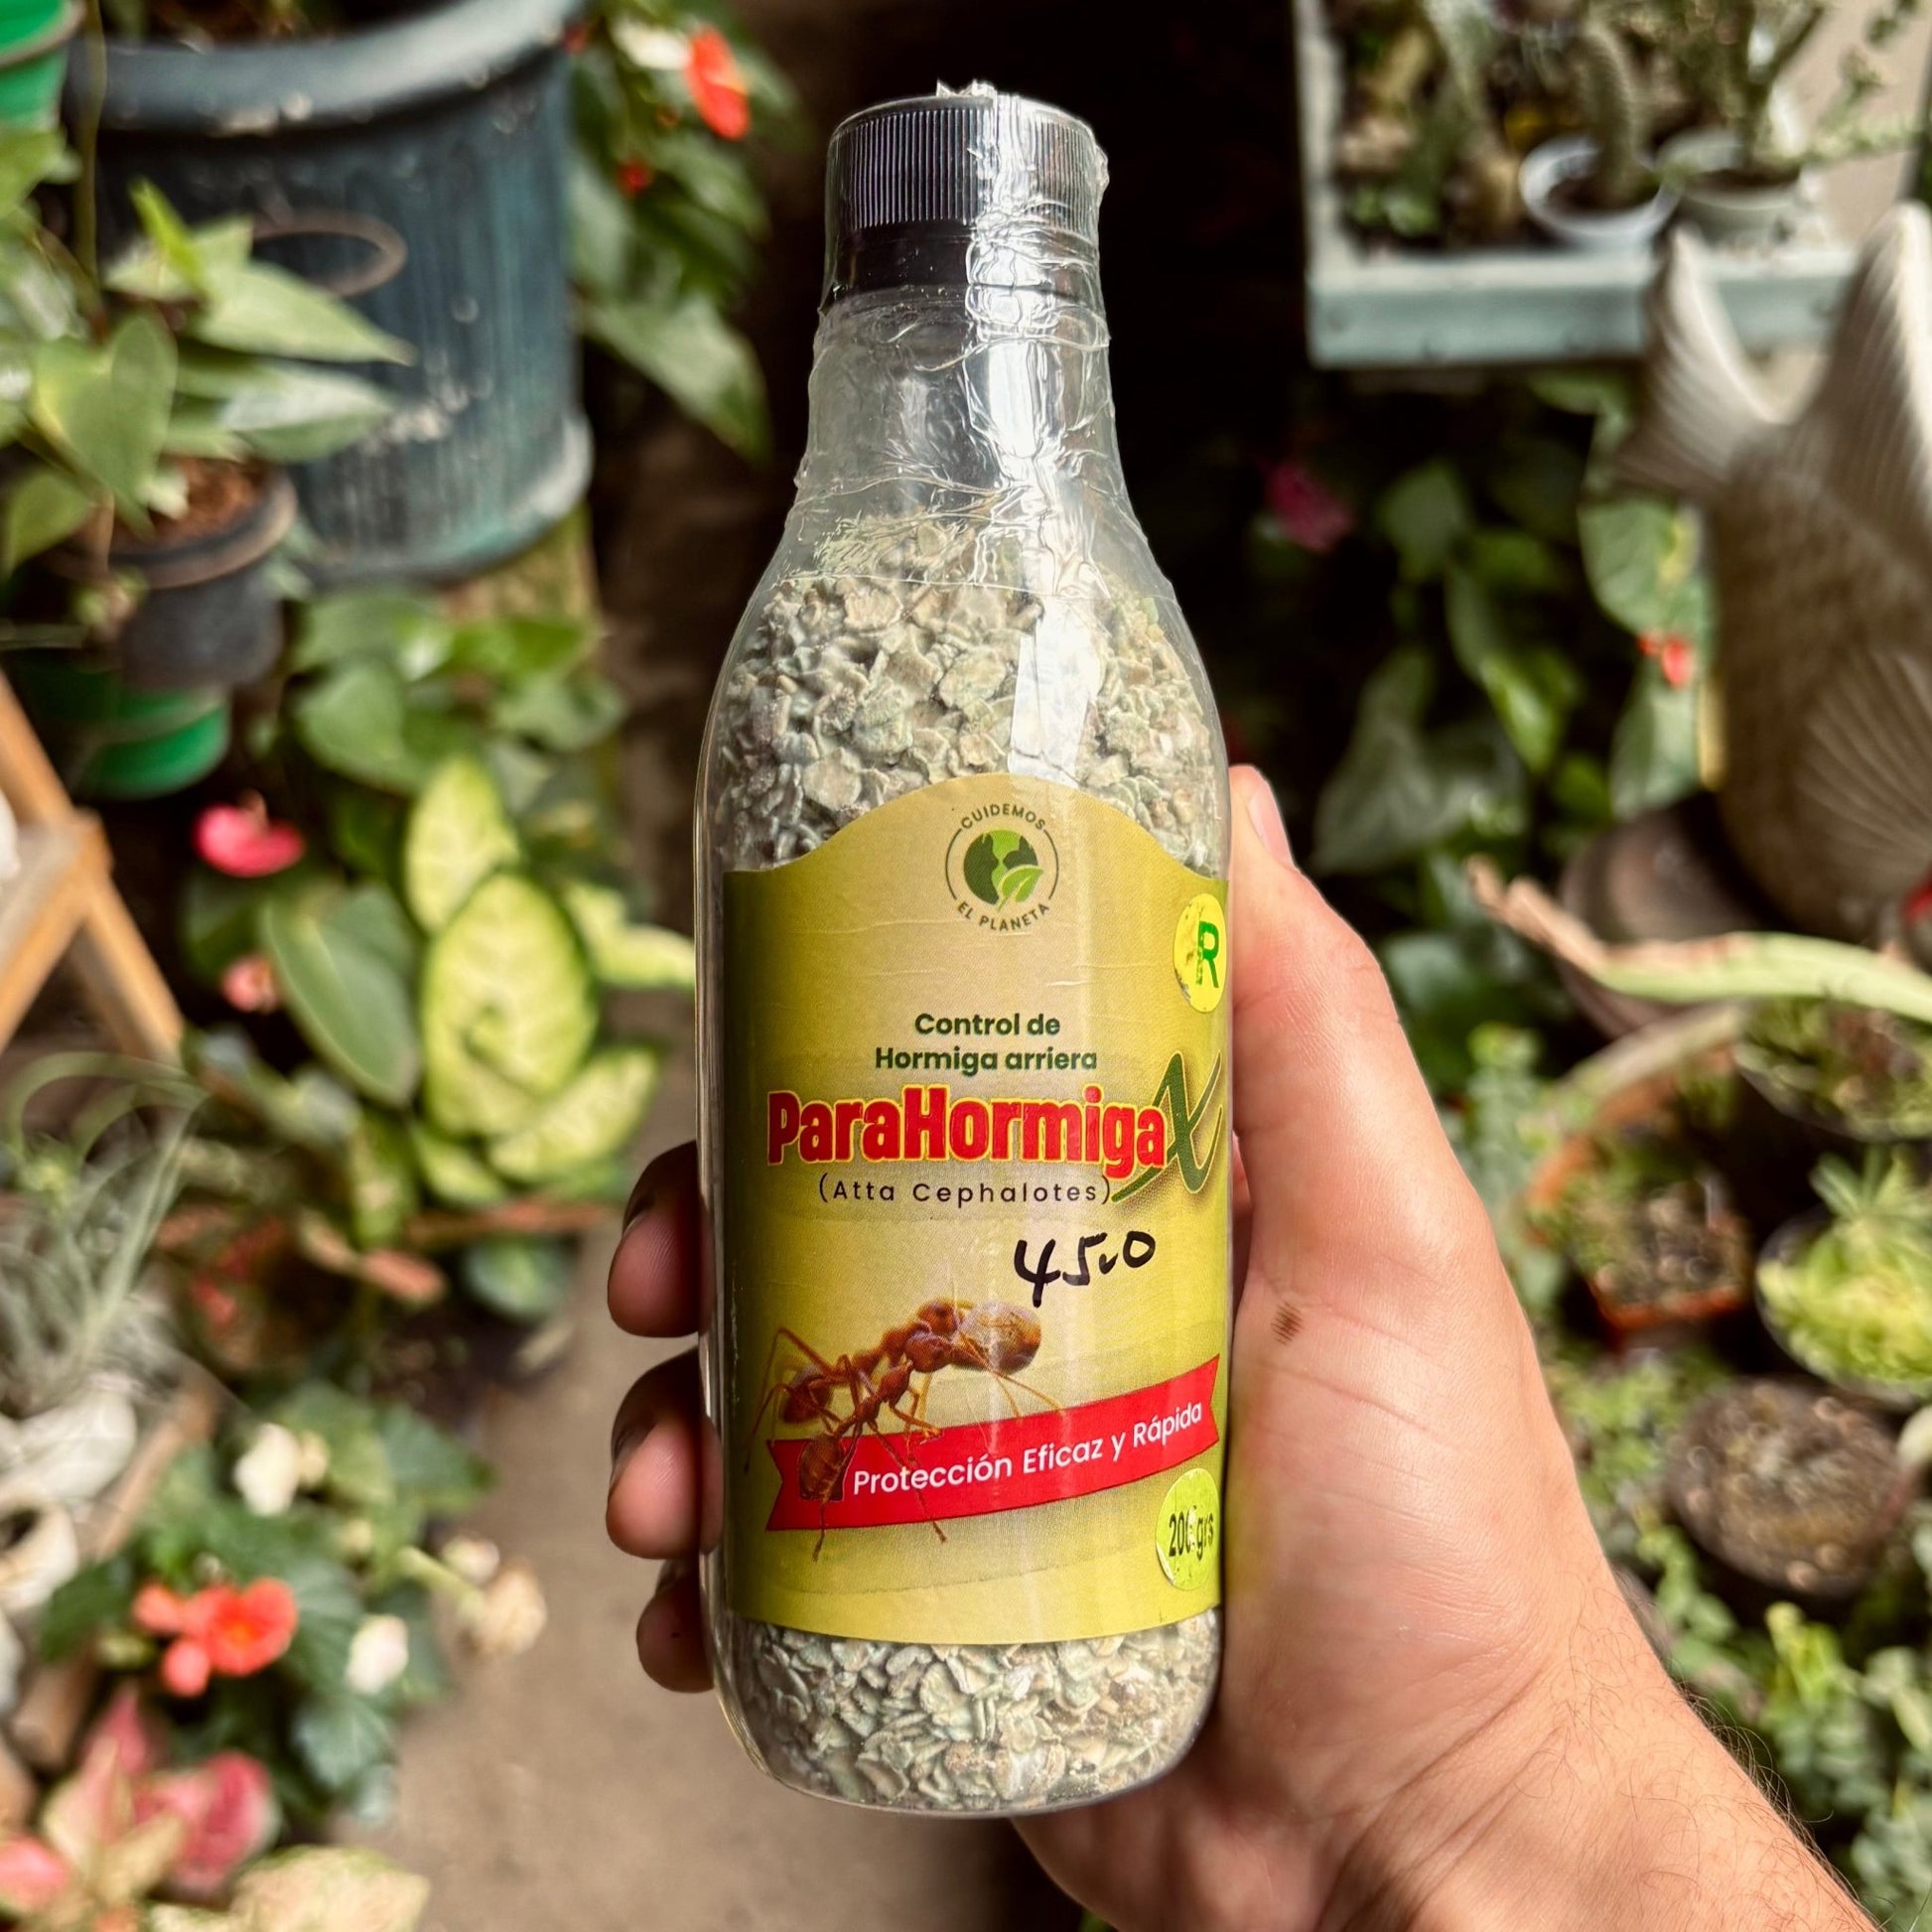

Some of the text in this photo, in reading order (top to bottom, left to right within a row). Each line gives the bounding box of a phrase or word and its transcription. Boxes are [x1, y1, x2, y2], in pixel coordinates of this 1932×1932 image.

[960, 803, 1046, 830] CUIDEMOS
[957, 901, 1049, 932] EL PLANETA
[1195, 920, 1220, 989] R
[914, 1013, 1061, 1035] Control de
[875, 1045, 1097, 1077] Hormiga arriera
[819, 1173, 1111, 1209] (Atta Cephalotes)
[853, 1402, 1202, 1496] Protección Eficaz y Rápida
